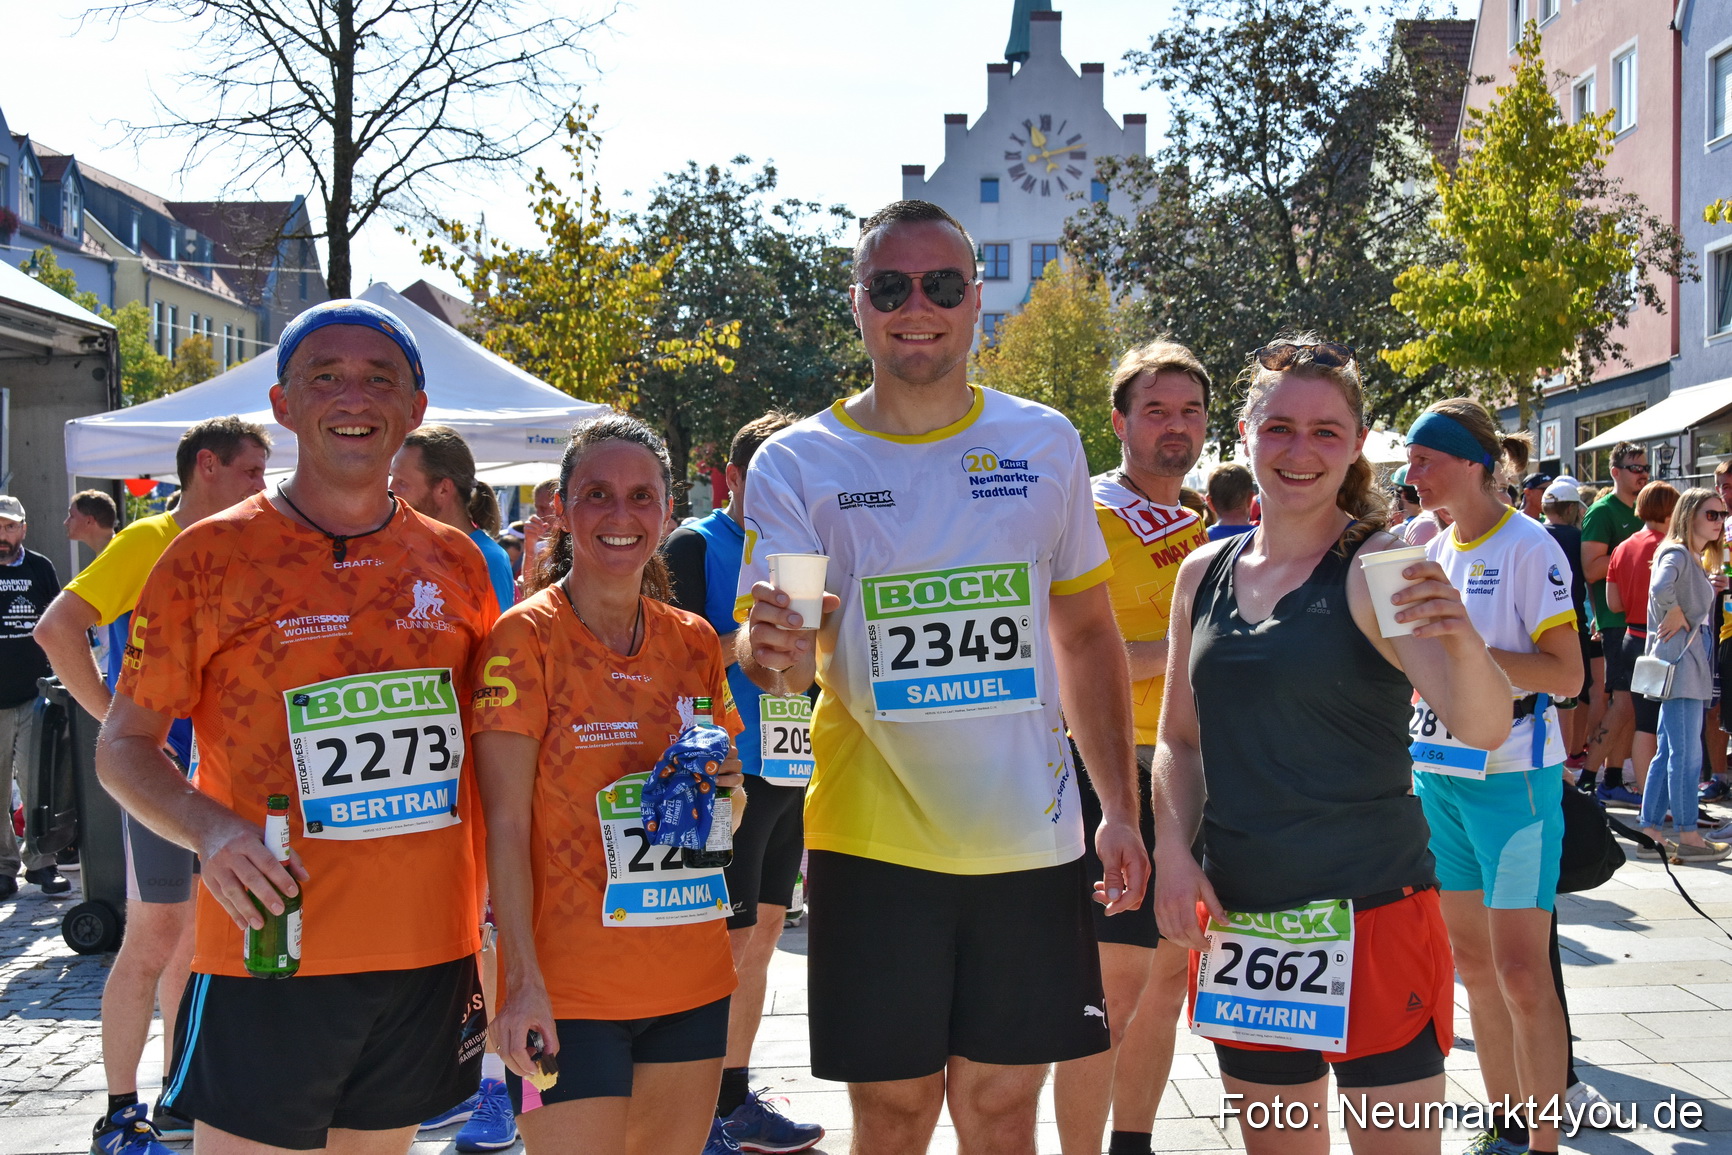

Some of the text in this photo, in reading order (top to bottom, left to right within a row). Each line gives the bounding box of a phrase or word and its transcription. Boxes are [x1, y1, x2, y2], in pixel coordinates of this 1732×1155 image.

[965, 454, 1026, 473] 20 JAHRE
[969, 472, 1040, 486] Neumarkter
[837, 490, 894, 506] BOCK
[972, 485, 1028, 499] Stadtlauf
[1150, 538, 1193, 570] MAX
[333, 559, 374, 569] CRAFT
[1470, 564, 1485, 577] 20
[874, 568, 1021, 614] BOCK
[288, 614, 351, 627] INTERSPORT
[1306, 607, 1331, 615] adidas
[283, 623, 348, 637] WOHLLEBEN
[888, 616, 1019, 670] 2349
[611, 672, 642, 682] CRAFT
[906, 677, 1011, 704] SAMUEL
[303, 675, 449, 726] BOCK
[583, 721, 639, 733] INTERSPORT
[579, 731, 637, 743] WOHLLEBEN
[316, 724, 451, 787] 2273
[331, 787, 449, 823] BERTRAM
[664, 799, 675, 824] GIPFEL
[642, 883, 713, 908] BIANKA
[1214, 942, 1329, 994] 2662
[1215, 1000, 1317, 1030] KATHRIN
